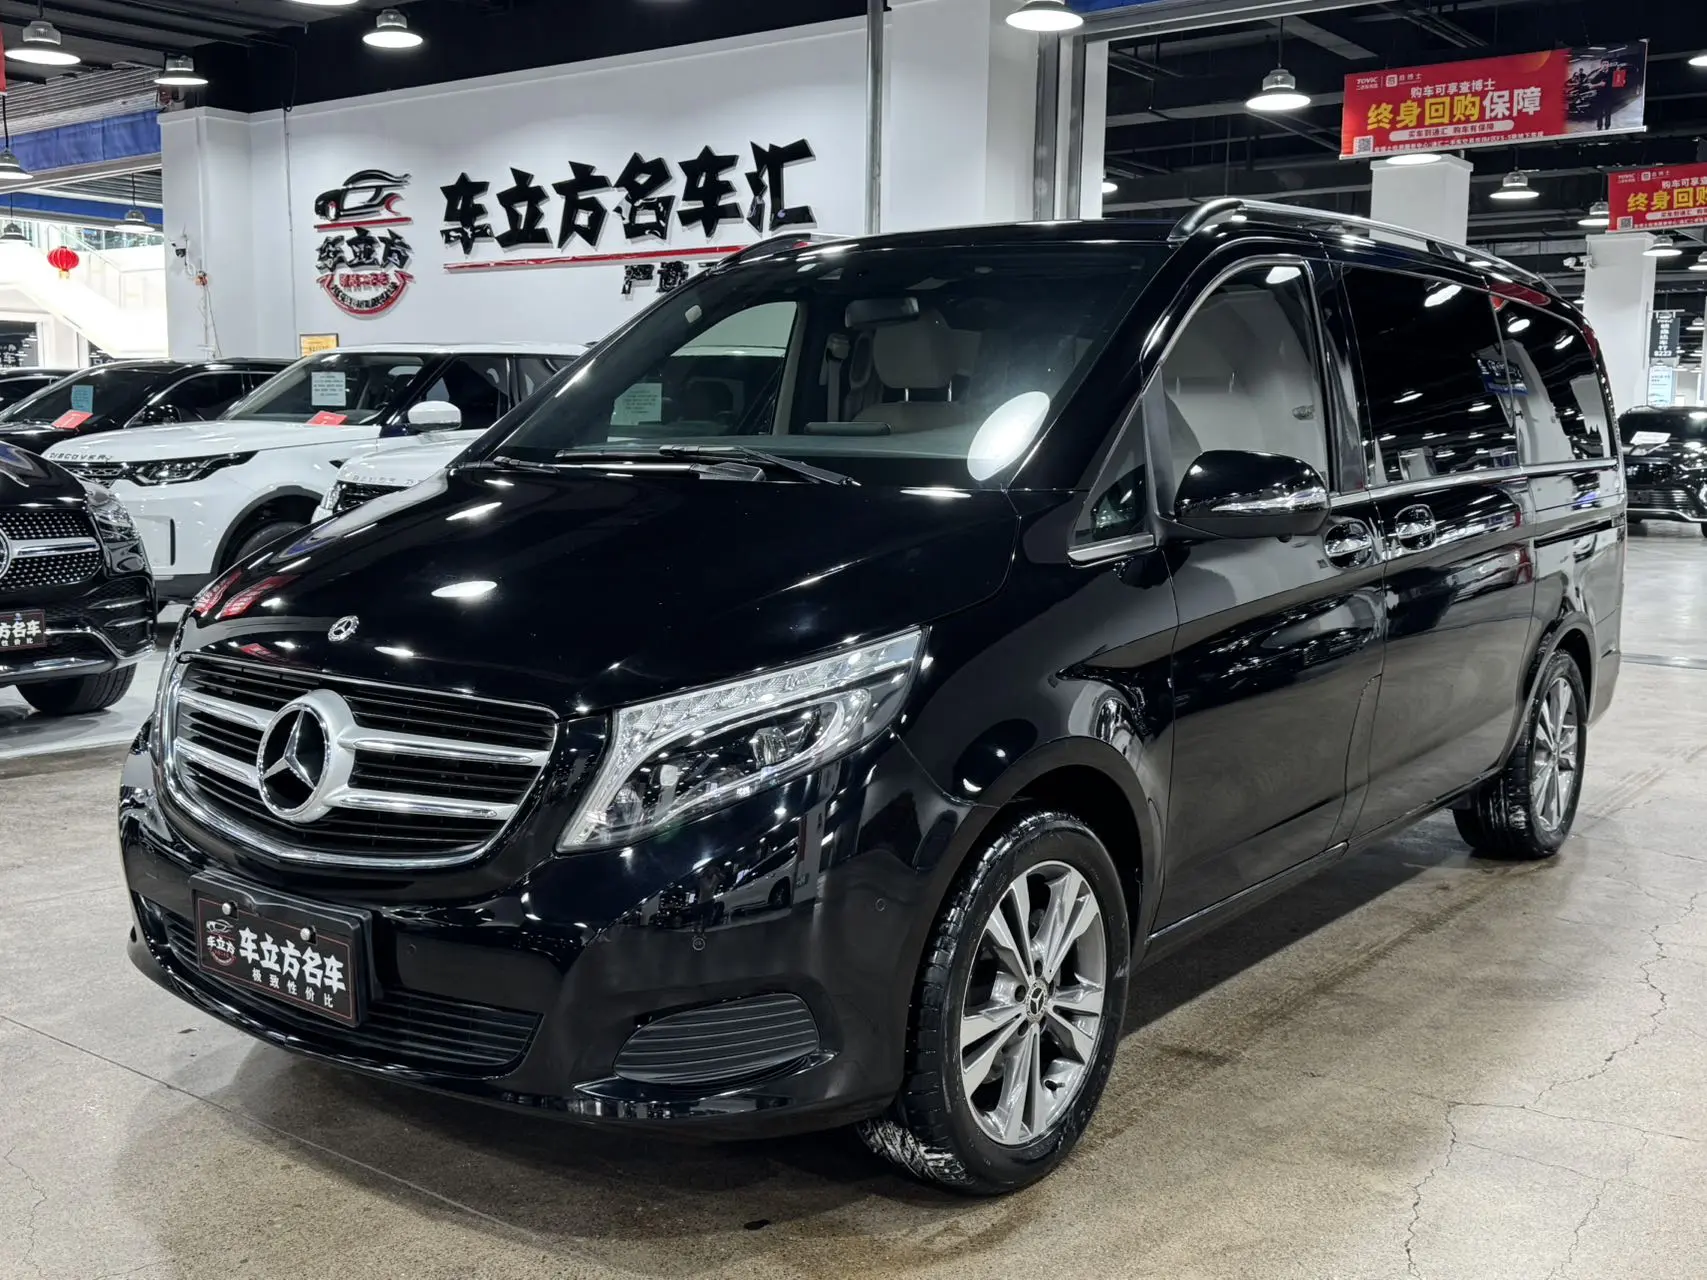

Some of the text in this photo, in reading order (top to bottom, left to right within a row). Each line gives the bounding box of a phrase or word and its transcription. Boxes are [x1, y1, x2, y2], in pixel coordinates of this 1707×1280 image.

[1367, 87, 1542, 131] 终身回购保障
[1411, 78, 1496, 98] 购车可享查博士
[440, 138, 815, 255] 车立方名车汇
[239, 926, 346, 993] 车立方名车
[252, 968, 333, 1008] 极致性价比
